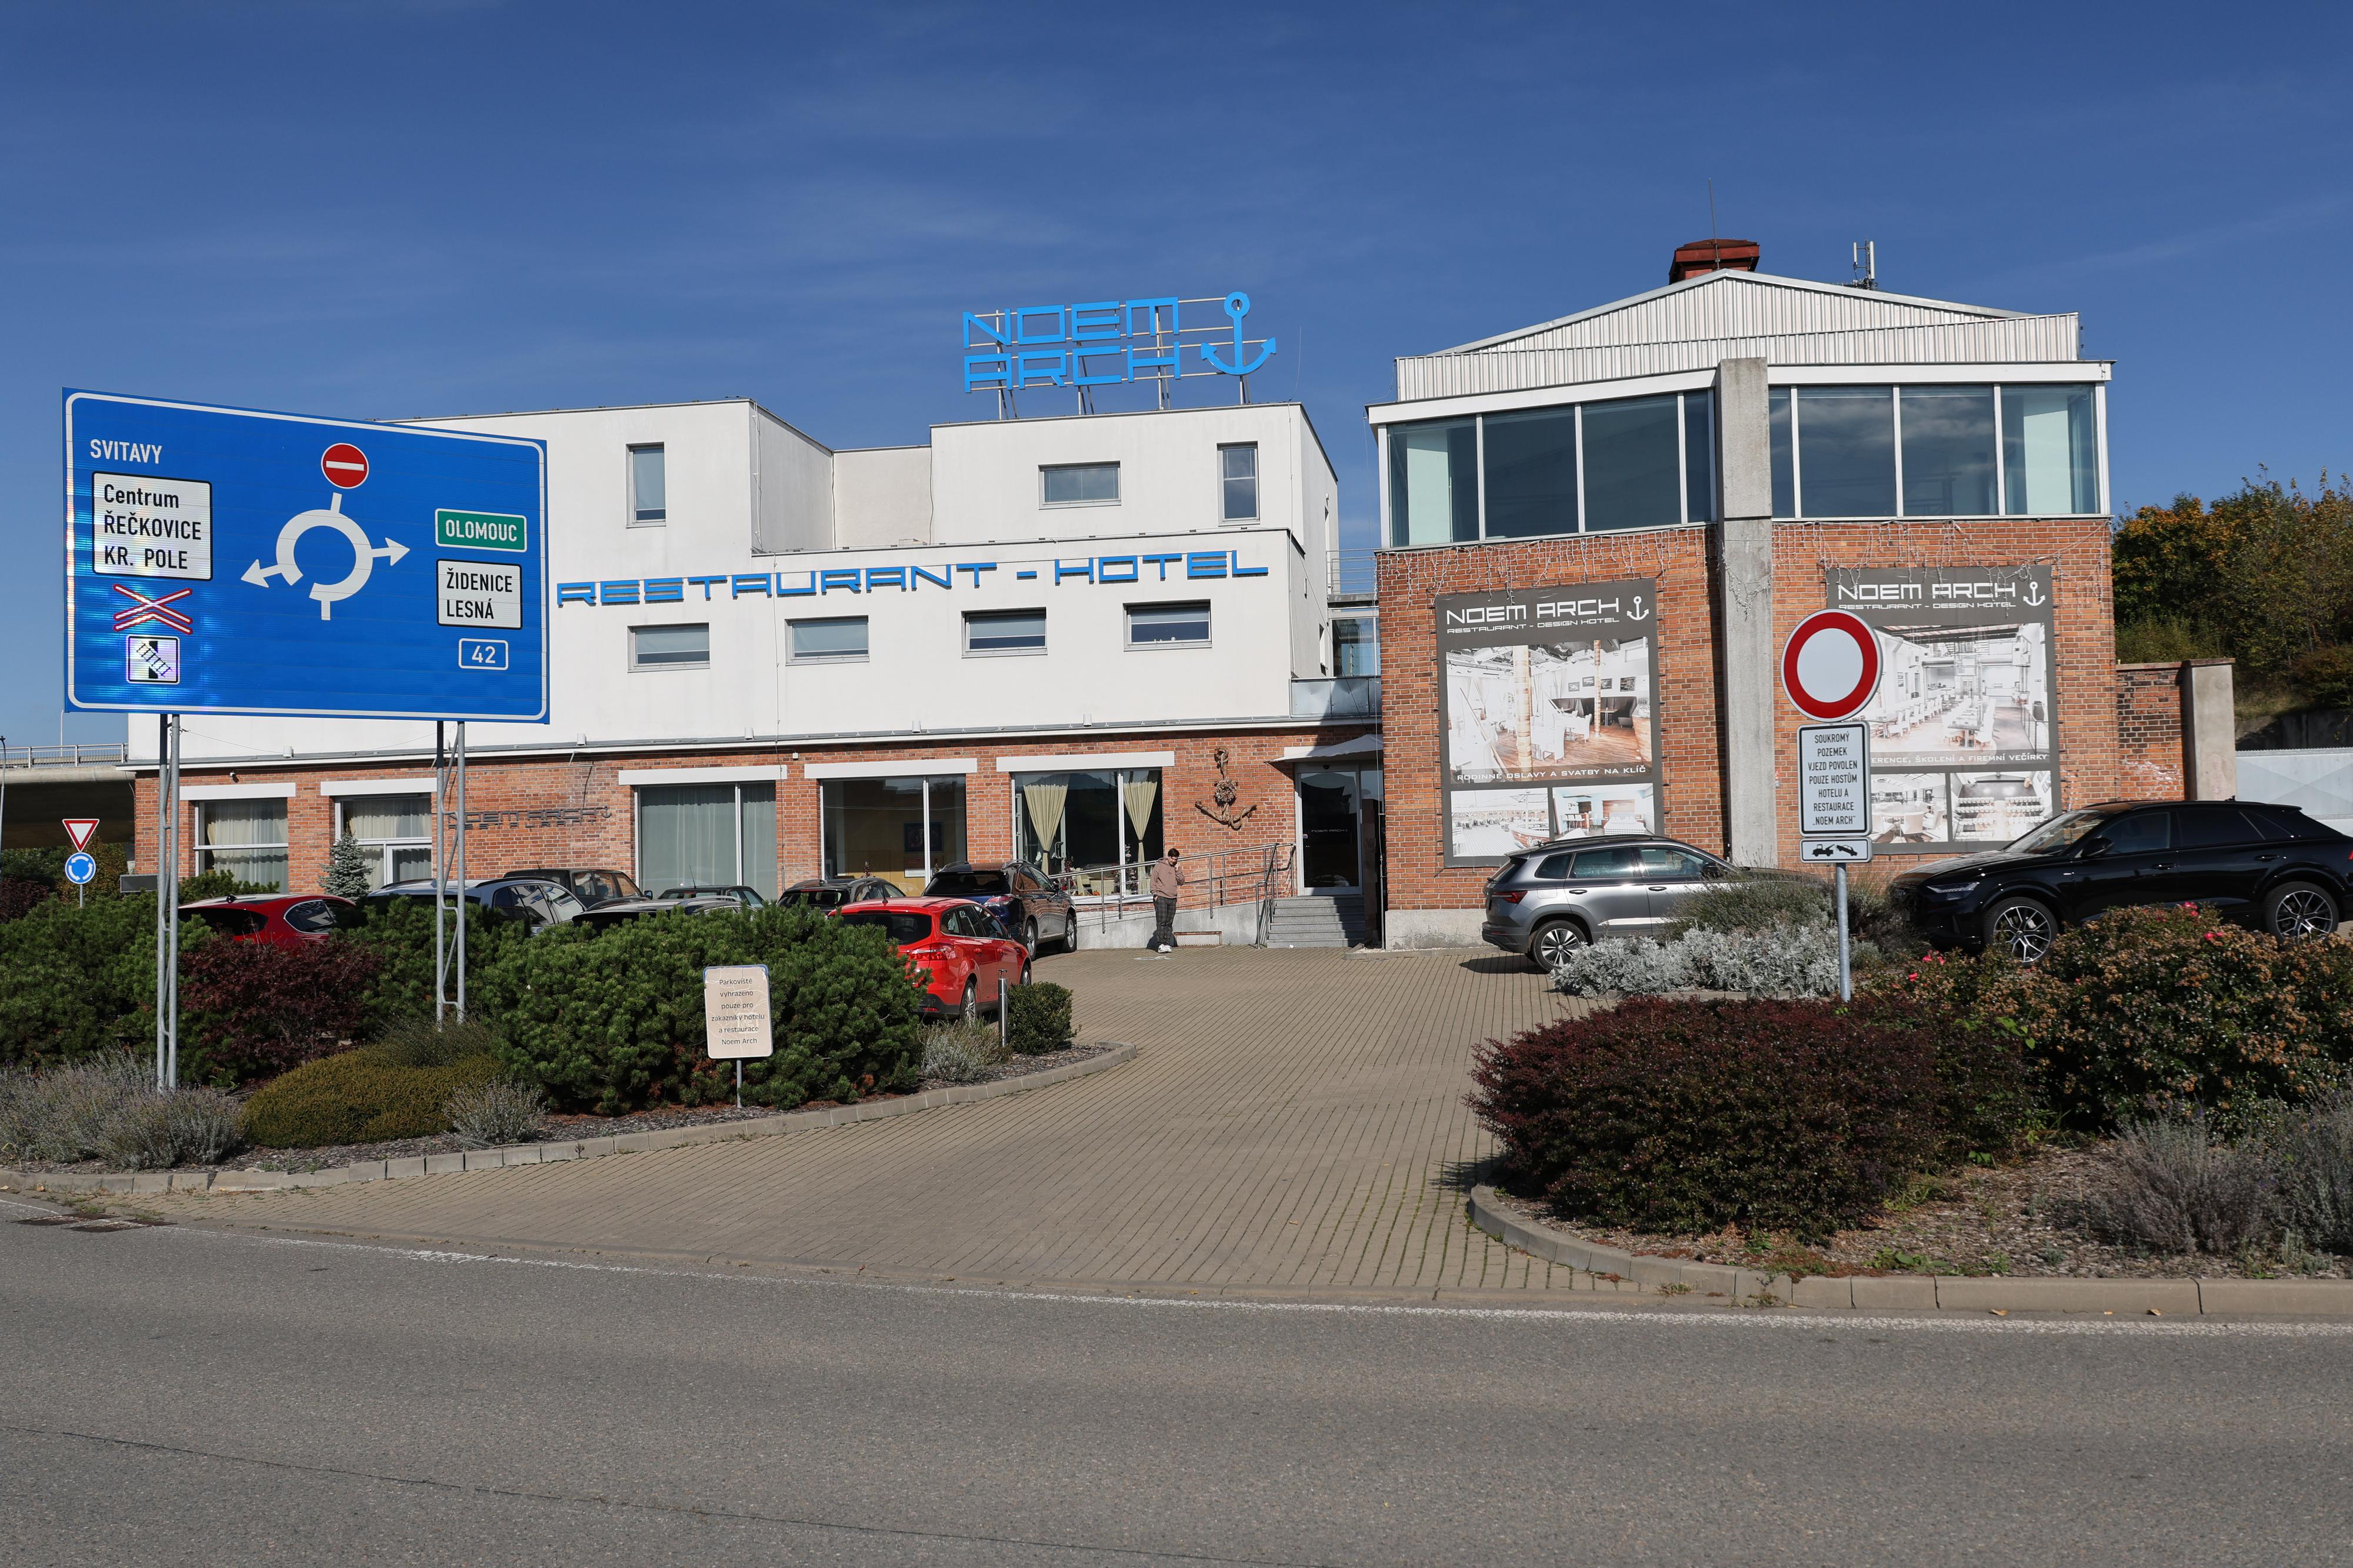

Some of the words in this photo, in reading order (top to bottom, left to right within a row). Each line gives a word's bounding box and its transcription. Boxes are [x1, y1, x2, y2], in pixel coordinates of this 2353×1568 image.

[963, 296, 1178, 349] NOEM
[964, 341, 1179, 393] ARCH
[90, 439, 162, 463] SVITAVY
[104, 483, 179, 508] Centrum
[104, 510, 202, 541] ŘEČKOVICE
[446, 519, 517, 542] OLOMOUC
[104, 546, 133, 566] KR.
[145, 549, 187, 569] POLE
[446, 567, 512, 593] ŽIDENICE
[557, 562, 996, 607] RESTAURANT
[1055, 549, 1269, 586] HOTEL
[1838, 583, 1922, 600] NOEM
[1932, 582, 2016, 599] ARCH
[446, 598, 494, 619] LESNÁ
[1447, 605, 1527, 625] NOEM
[1537, 598, 1619, 618] ARCH
[1447, 624, 1527, 633] RESTAURANT
[472, 646, 496, 664] 42
[1815, 731, 1849, 743] SOUKROMÝ
[1818, 747, 1847, 756] POZEMEK
[1915, 754, 1955, 762] ŠKOLENÍ
[1969, 753, 2005, 762] FIREMNÍ
[2009, 752, 2048, 760] VEČÍRKY
[1808, 762, 1827, 771] VJEZD
[1829, 760, 1857, 770] POVOLEN
[1457, 772, 1502, 780] RODINNÉ
[1809, 775, 1829, 784] POUZE
[1831, 772, 1857, 783] HOSTŮM
[1818, 789, 1842, 798] HOTELU
[1844, 788, 1848, 797] A
[527, 808, 596, 820] ARCH
[1814, 802, 1854, 812] RESTAURACE
